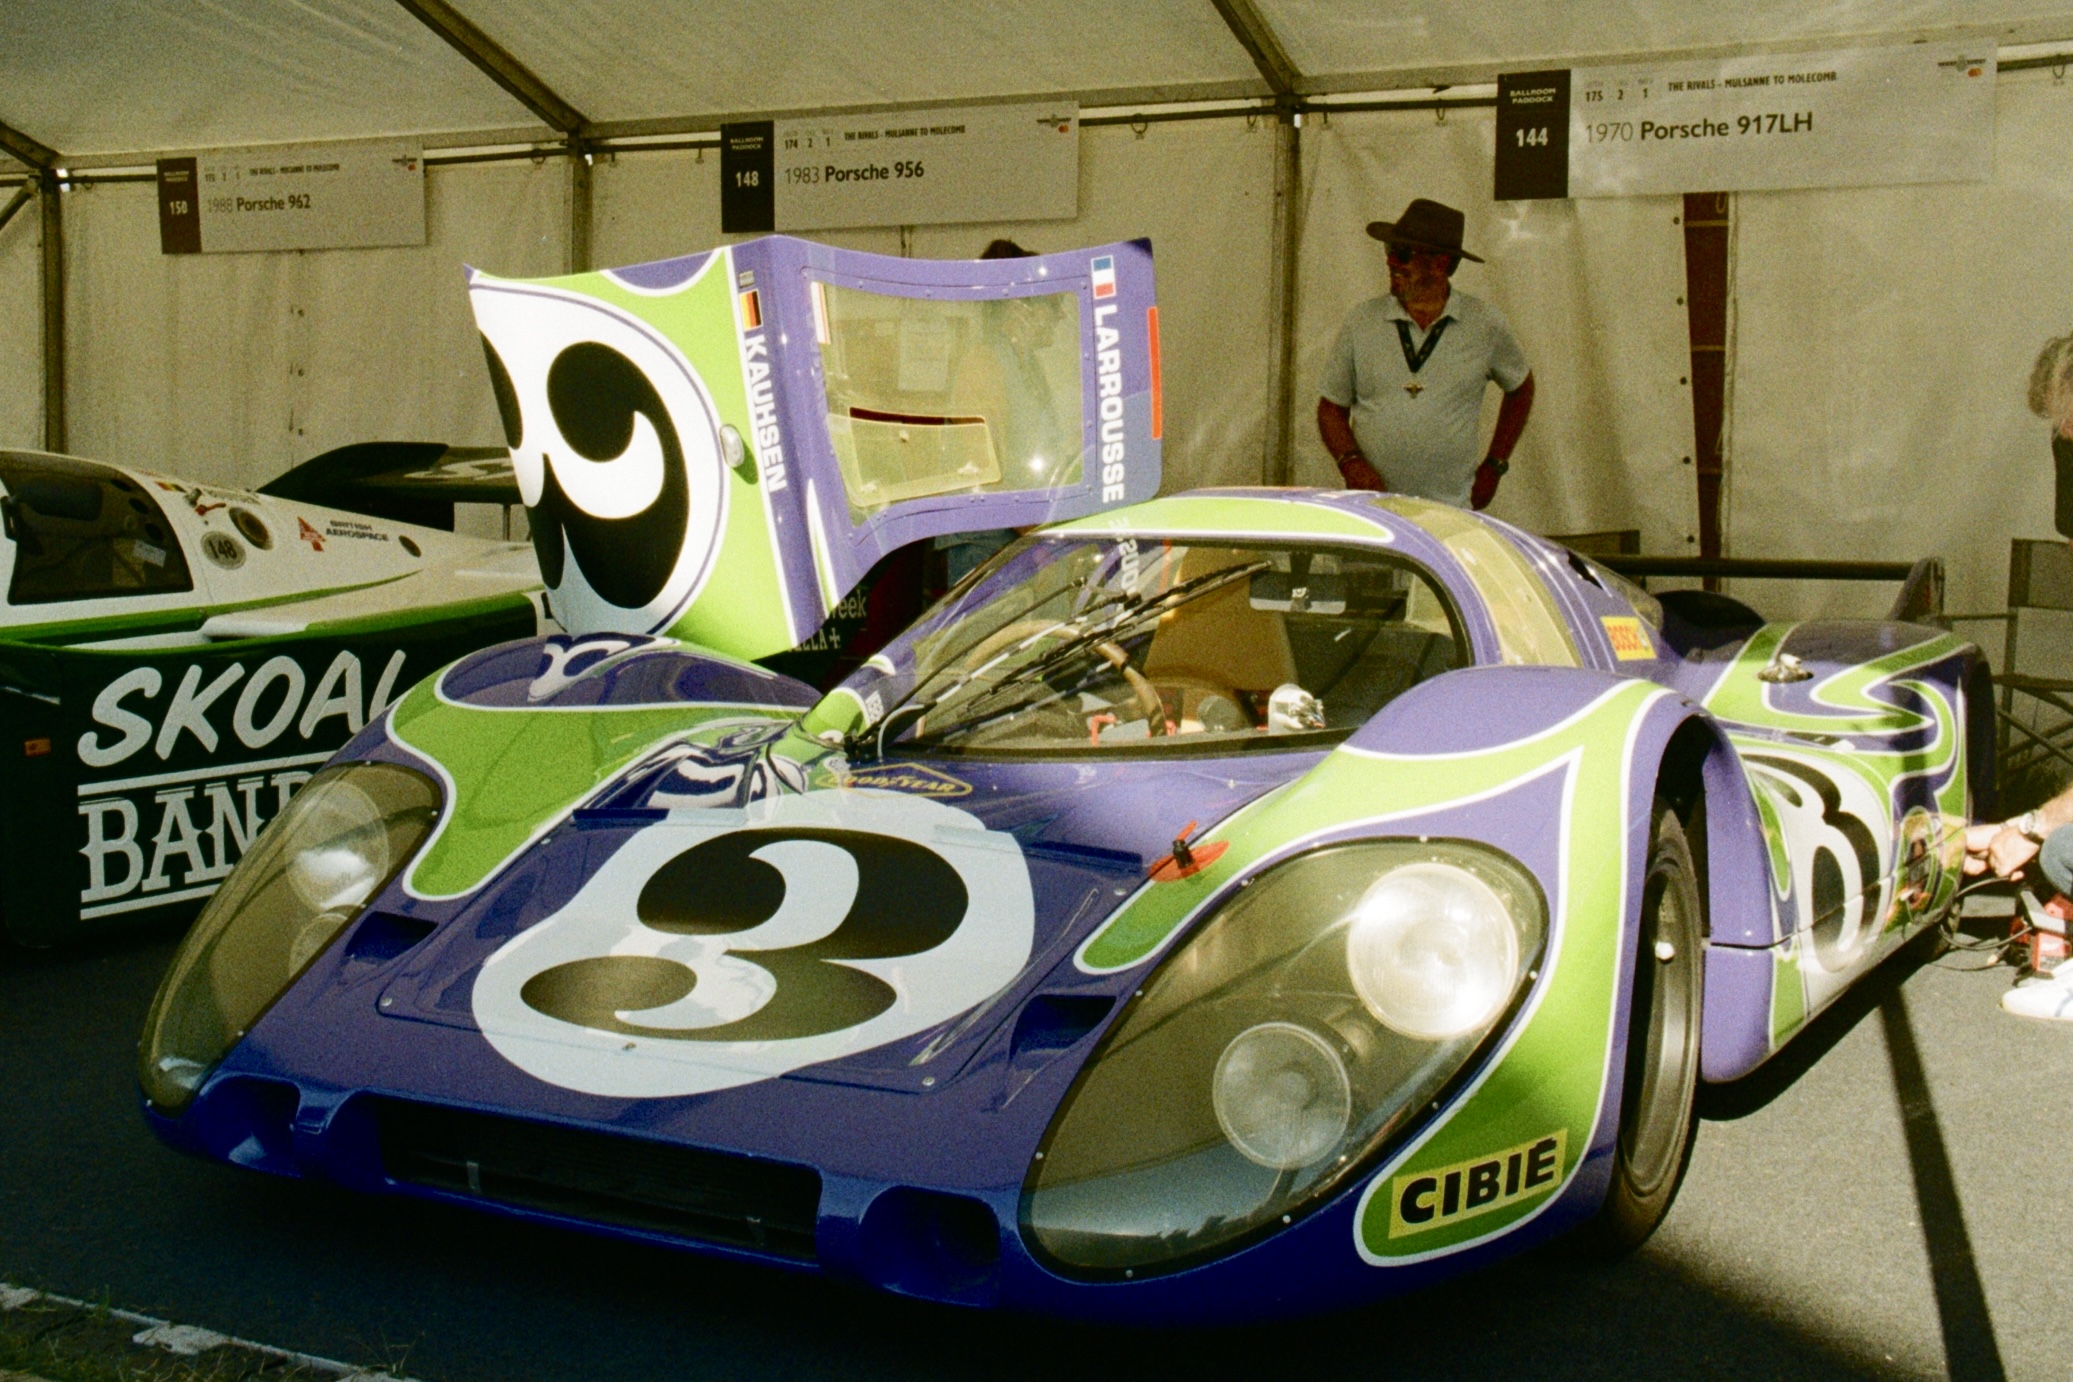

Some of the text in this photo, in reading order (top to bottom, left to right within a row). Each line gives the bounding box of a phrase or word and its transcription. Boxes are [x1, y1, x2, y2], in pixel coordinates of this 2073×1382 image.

[1668, 82, 1684, 91] THE
[1687, 80, 1715, 90] RIVALS
[1725, 76, 1770, 88] MULSANNE
[1774, 75, 1785, 85] TO
[1788, 72, 1837, 83] MOLECOMB
[1510, 88, 1556, 97] BALLROOM
[1512, 96, 1553, 104] PADDOCK
[1586, 91, 1603, 102] 175
[1618, 89, 1624, 100] 2
[1586, 112, 1813, 143] 1970 Porsche 917LH
[1516, 128, 1548, 147] 144
[736, 171, 759, 187] 148
[785, 161, 924, 184] 1983 Porsche 956
[170, 201, 188, 215] 150
[236, 197, 285, 212] Porsche
[288, 194, 311, 209] 962
[1095, 304, 1125, 503] LARROUSSE
[745, 334, 788, 493] KAUHSEN
[326, 528, 389, 541] AEROSPACE
[208, 540, 238, 559] 148
[520, 826, 970, 1042] 3
